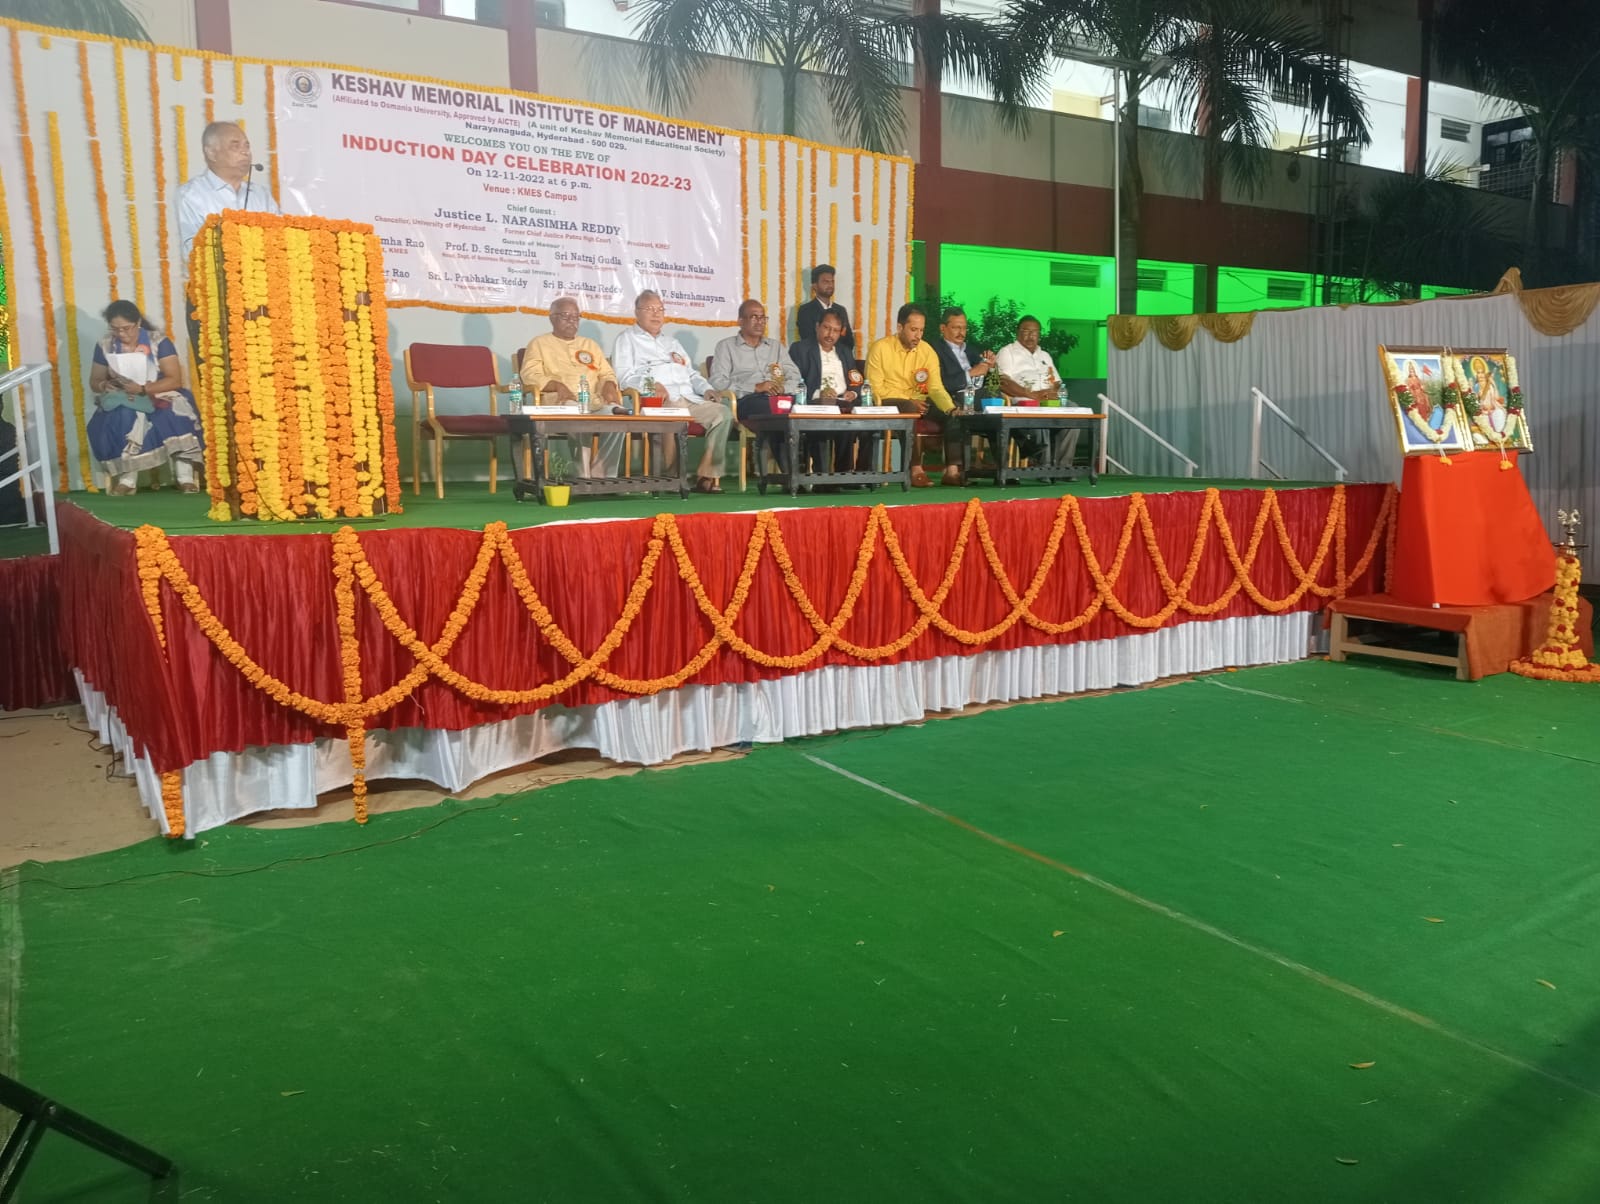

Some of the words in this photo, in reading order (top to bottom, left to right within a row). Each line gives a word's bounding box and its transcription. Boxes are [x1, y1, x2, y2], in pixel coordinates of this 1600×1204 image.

[331, 73, 406, 99] KESHAV
[411, 85, 504, 113] MEMORIAL
[509, 99, 594, 126] INSTITUTE
[599, 112, 619, 129] OF
[623, 117, 725, 146] MANAGEMENT
[332, 94, 369, 106] (Affiliated
[370, 99, 379, 107] to
[380, 100, 413, 112] Osmania
[414, 105, 451, 118] University,
[453, 111, 487, 124] Approved
[488, 115, 496, 126] by
[497, 117, 521, 128] AICTE)
[465, 121, 534, 138] Narayanaguda,
[537, 131, 584, 144] Hyderabad
[591, 139, 607, 148] 500
[609, 141, 627, 151] 029.
[528, 121, 537, 130] (A
[539, 122, 557, 132] unit
[559, 125, 568, 134] of
[570, 127, 601, 138] Keshav
[604, 131, 643, 144] Memorial
[645, 137, 692, 151] Educational
[694, 144, 726, 158] Society)
[444, 133, 506, 149] WELCOMES
[509, 141, 530, 152] YOU
[533, 144, 548, 155] ON
[551, 147, 573, 158] THE
[575, 150, 595, 161] EVE
[597, 153, 611, 163] OF
[342, 133, 455, 161] INDUCTION
[461, 148, 498, 166] DAY
[503, 154, 626, 182] CELEBRATION
[631, 170, 692, 191] 2022-23
[466, 167, 482, 177] On
[485, 169, 545, 185] 12-11-2022
[547, 176, 559, 186] at
[561, 178, 568, 187] 6
[570, 180, 592, 191] p.m.
[482, 183, 510, 195] Venue
[517, 187, 542, 198] KMES
[544, 191, 578, 203] Campus
[507, 204, 527, 213] Chief
[529, 206, 552, 216] Guest
[434, 207, 482, 222] Justice
[486, 212, 498, 223] L.
[502, 214, 578, 231] NARASIMHA
[581, 222, 621, 236] REDDY
[405, 238, 424, 248] Rao
[445, 242, 469, 252] Prof.
[472, 243, 481, 253] D.
[555, 251, 568, 261] Sri
[571, 252, 596, 265] Natraj
[634, 259, 647, 268] Sri
[649, 260, 686, 272] Sudhakar
[392, 269, 410, 278] Rao
[444, 272, 453, 281] L.
[455, 273, 499, 285] Prabhakar
[501, 277, 529, 289] Reddy
[543, 279, 555, 289] Sri
[557, 281, 566, 290] B.
